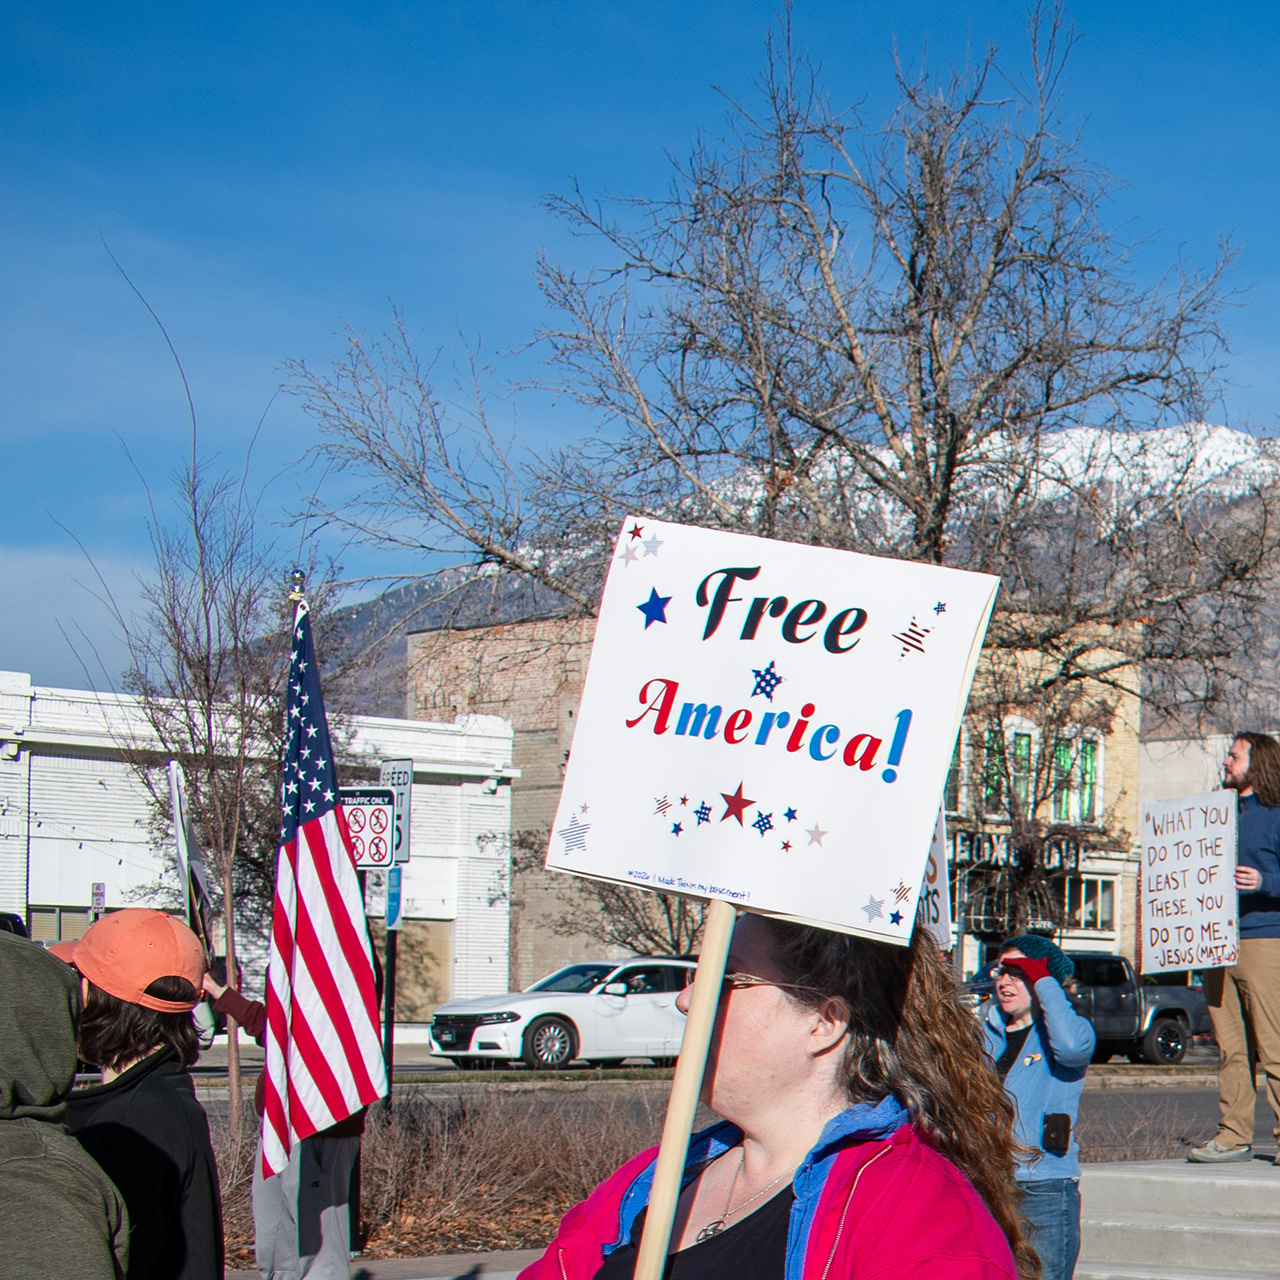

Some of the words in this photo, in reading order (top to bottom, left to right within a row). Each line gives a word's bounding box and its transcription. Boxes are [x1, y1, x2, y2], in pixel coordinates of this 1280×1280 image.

[695, 565, 868, 654] Free
[625, 678, 913, 784] America!
[344, 796, 371, 805] TRAFFIC
[371, 796, 390, 805] ONLY
[1200, 806, 1229, 828] YOU
[1148, 845, 1168, 867] DO
[1174, 840, 1192, 861] TO
[1197, 837, 1224, 858] THE
[1148, 869, 1190, 893] LEAST
[1197, 865, 1219, 885] OF
[1148, 898, 1193, 918] THESE,
[1197, 894, 1224, 912] YOU
[1150, 927, 1169, 947] DO
[1175, 925, 1194, 944] TO
